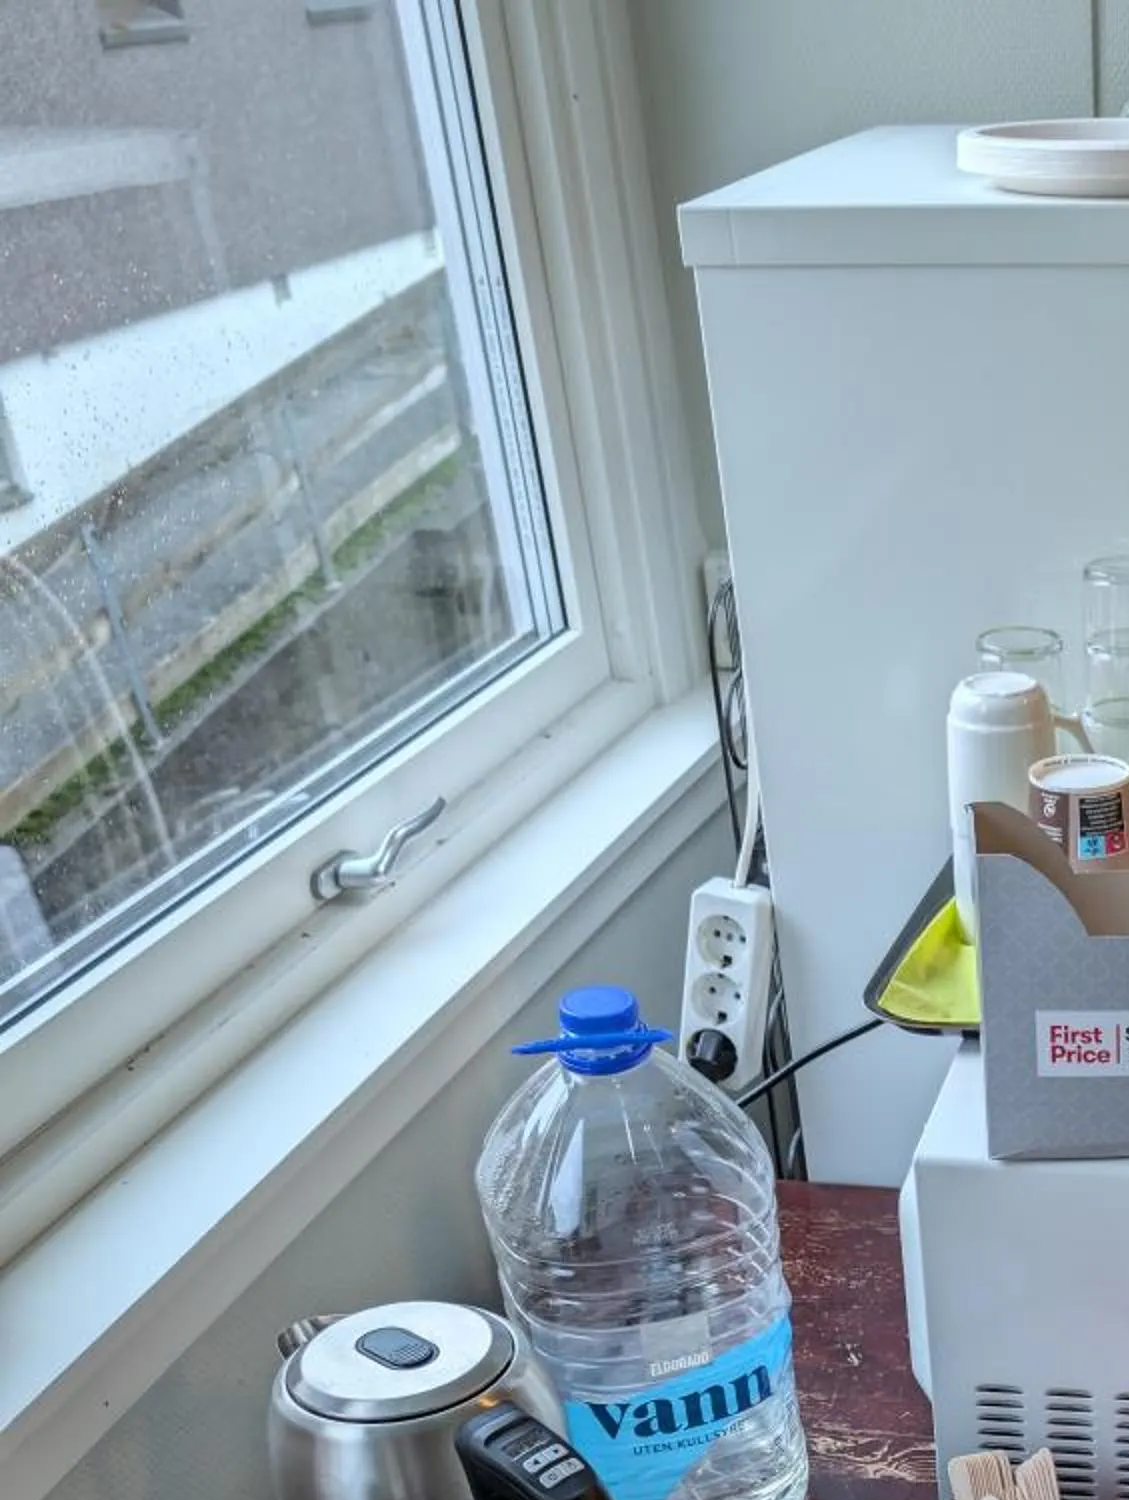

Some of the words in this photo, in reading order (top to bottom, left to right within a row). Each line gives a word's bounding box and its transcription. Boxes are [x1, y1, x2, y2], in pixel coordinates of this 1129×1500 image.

[1050, 1024, 1103, 1044] First
[1050, 1044, 1112, 1064] Price
[650, 1351, 710, 1377] ELDORADO
[633, 1441, 673, 1456] UTEN
[677, 1417, 748, 1449] KULLSYRE
